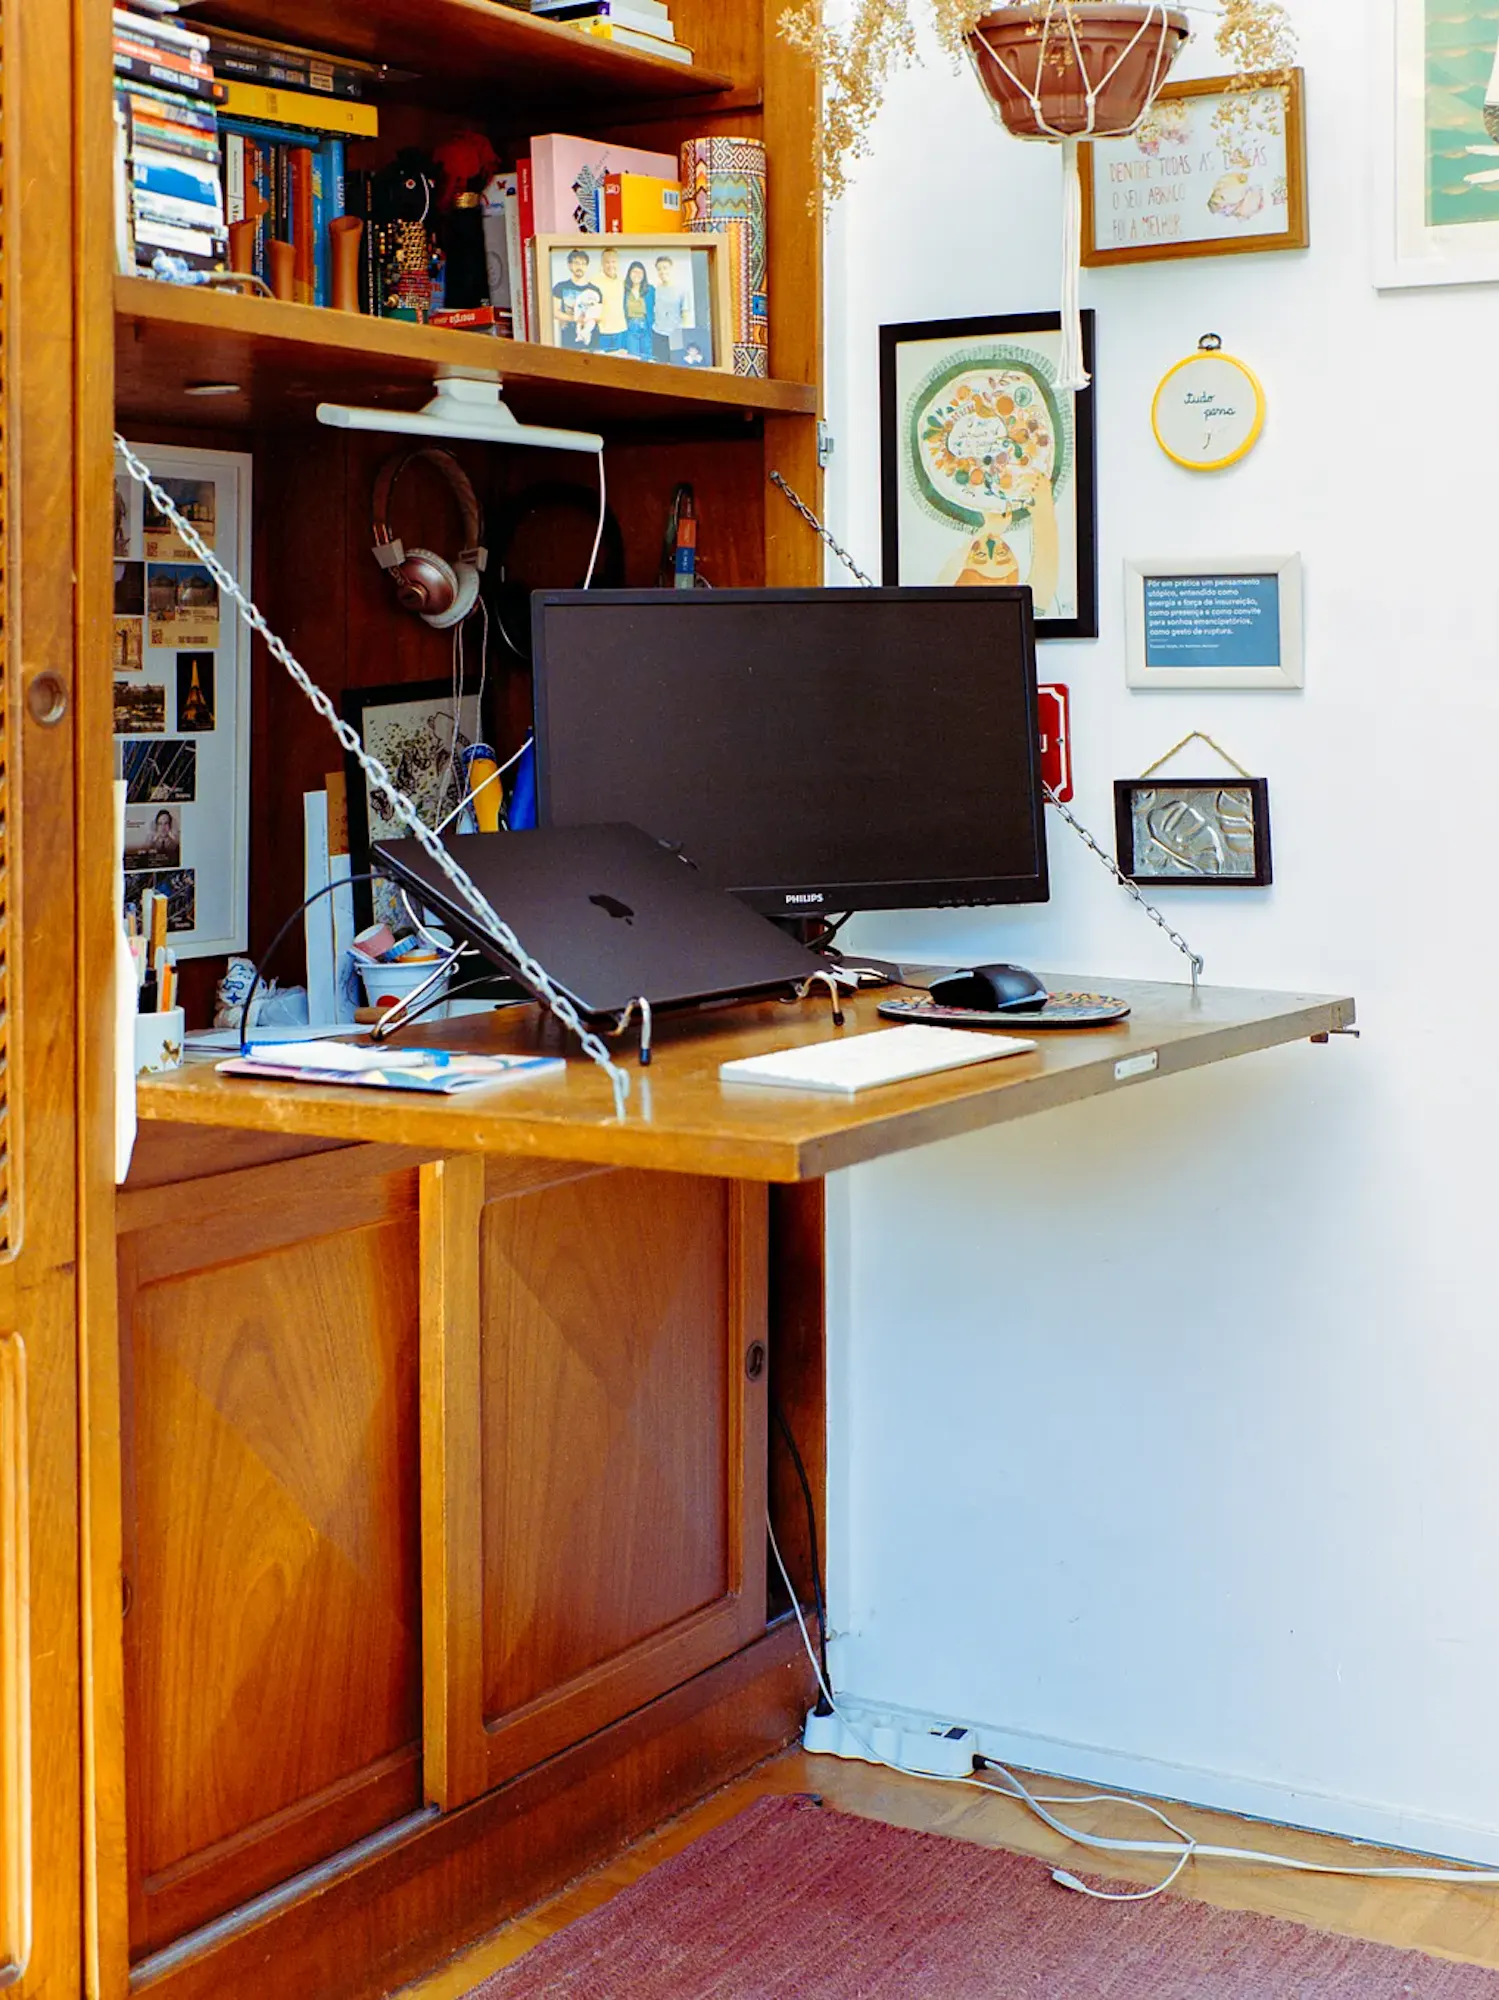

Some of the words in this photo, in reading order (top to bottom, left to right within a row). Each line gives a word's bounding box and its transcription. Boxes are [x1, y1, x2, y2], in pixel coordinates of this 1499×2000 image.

[1109, 160, 1151, 182] DENTRE
[1160, 155, 1192, 176] TODAS
[1199, 151, 1214, 171] AS
[1113, 191, 1120, 210] O
[1130, 217, 1137, 238] A
[1183, 391, 1215, 404] tudo
[1174, 579, 1200, 588] prática
[1215, 578, 1260, 587] pensamento
[1179, 588, 1216, 596] entendido
[1148, 599, 1176, 608] energia
[1183, 599, 1202, 609] força
[1203, 598, 1213, 606] de
[1148, 609, 1169, 617] como
[1170, 609, 1204, 618] presença
[1233, 607, 1261, 616] convite
[1167, 618, 1192, 626] sonhos
[1149, 628, 1170, 636] como
[1171, 628, 1192, 637] gesto
[1193, 627, 1203, 635] de
[1204, 628, 1234, 637] ruptura.
[785, 893, 824, 904] PHILIPS
